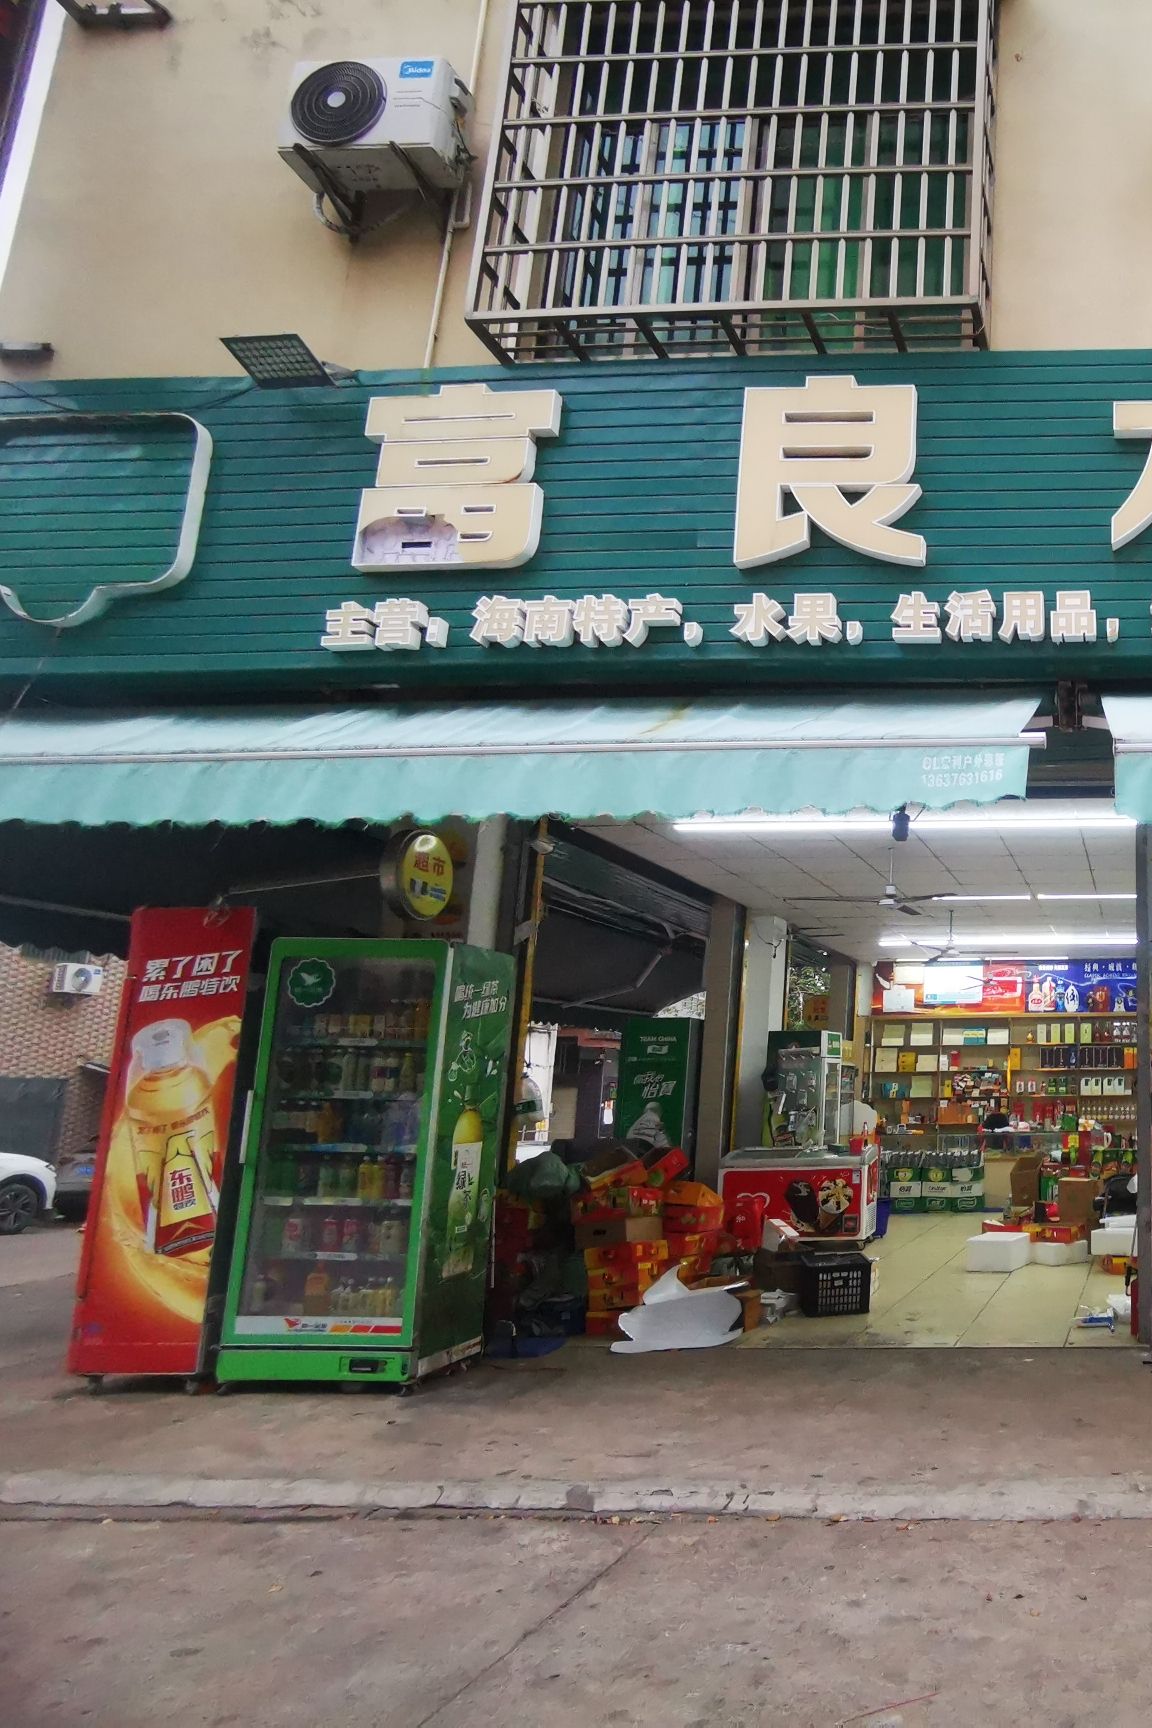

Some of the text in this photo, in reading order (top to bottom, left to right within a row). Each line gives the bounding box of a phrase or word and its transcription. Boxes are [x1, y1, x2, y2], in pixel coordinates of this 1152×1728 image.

[921, 769, 1003, 787] 13637631616
[414, 852, 445, 876] 超市
[142, 949, 243, 983] 累了困了
[137, 976, 241, 1002] 喝东鹏特饮
[169, 1167, 195, 1203] 东鹏
